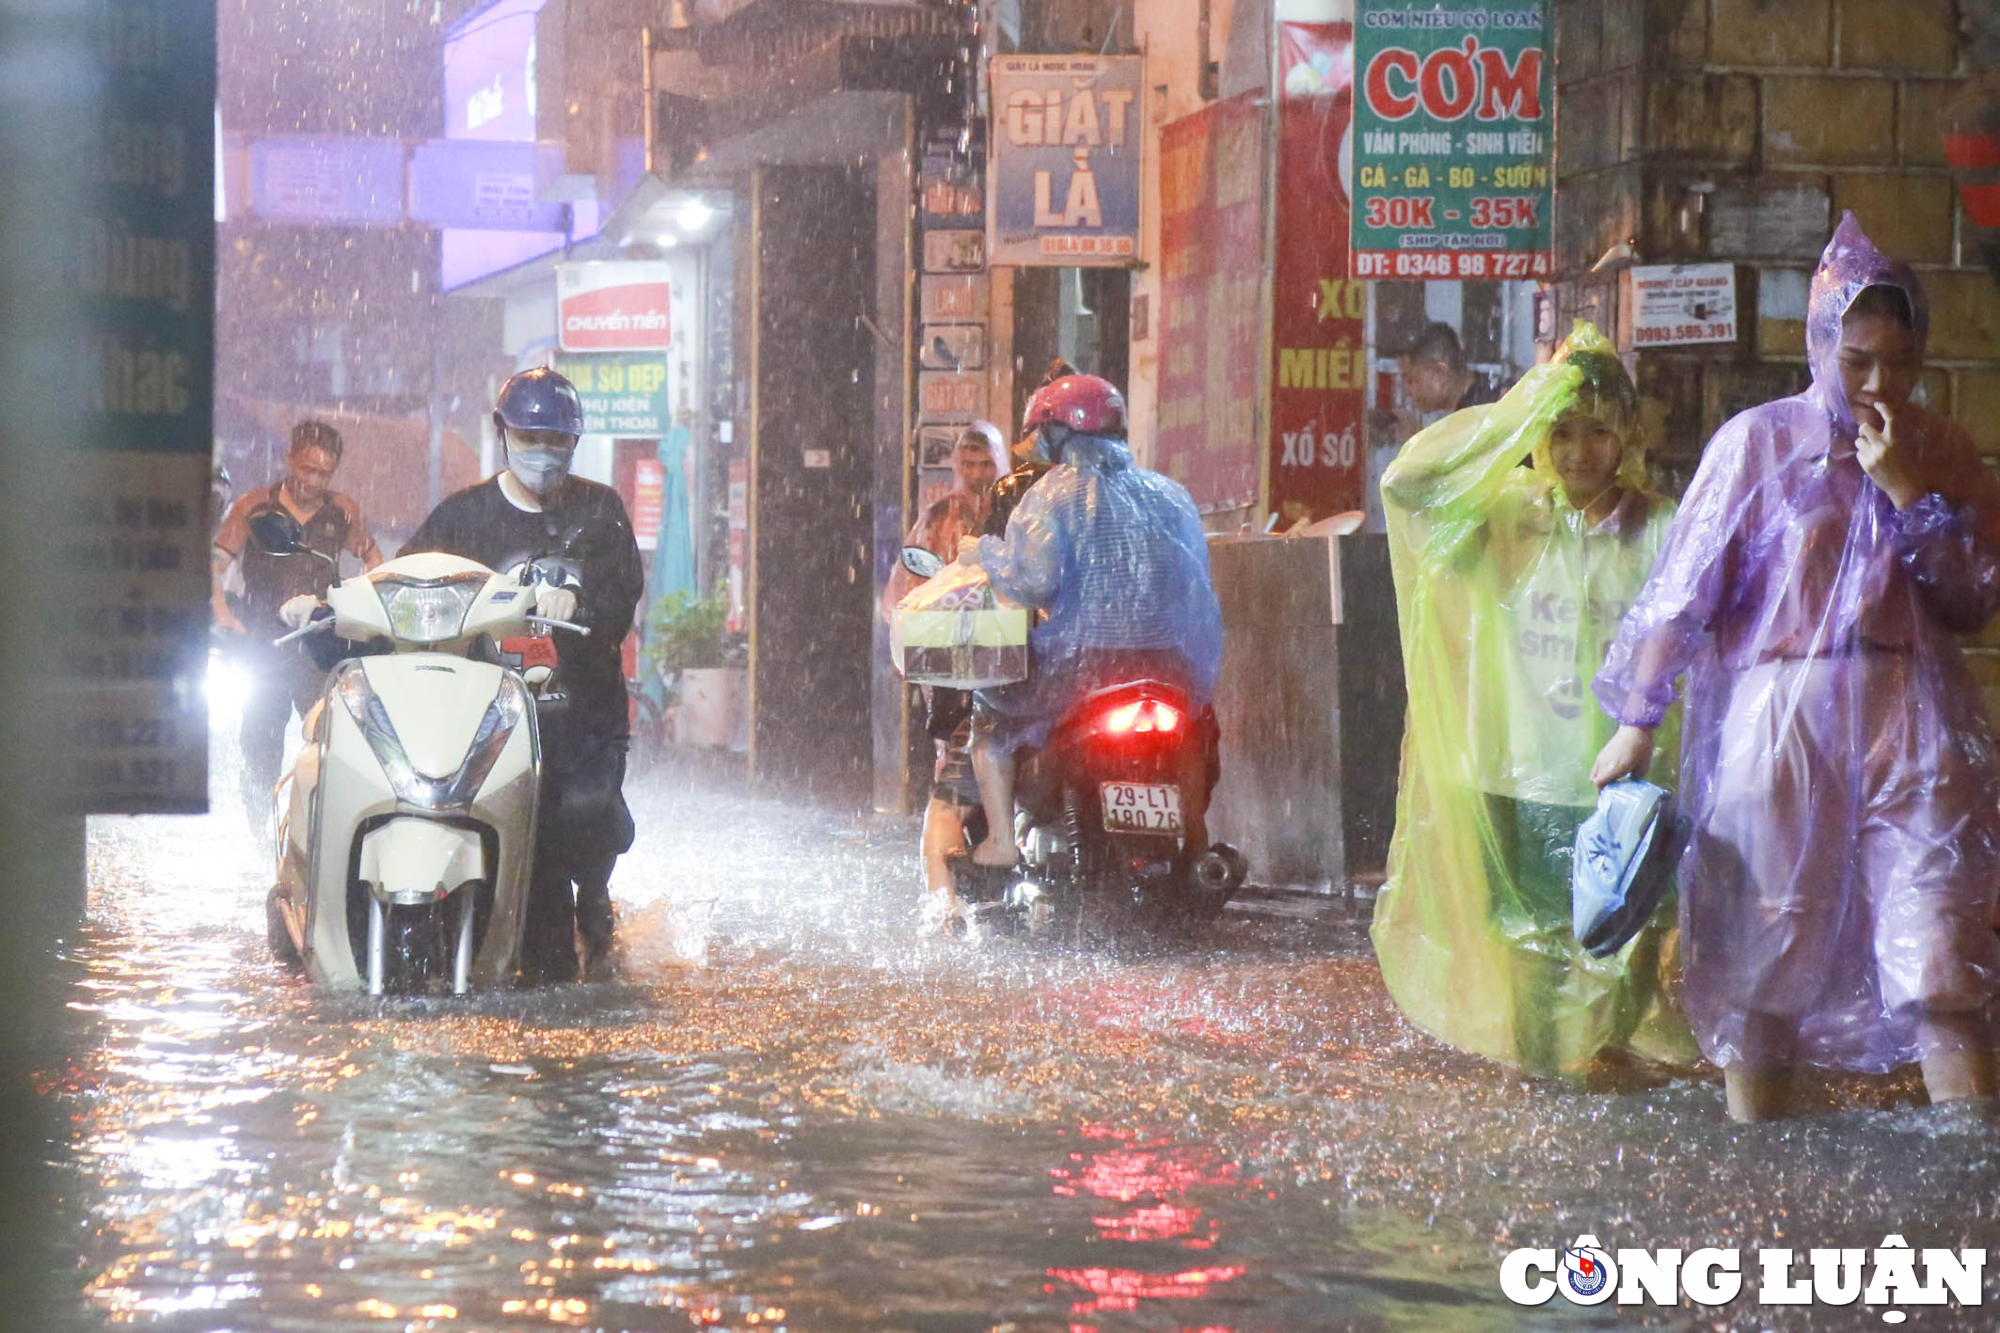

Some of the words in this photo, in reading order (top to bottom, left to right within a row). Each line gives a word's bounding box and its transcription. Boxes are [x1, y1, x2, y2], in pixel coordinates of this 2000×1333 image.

[1364, 34, 1544, 121] CƠM
[1466, 132, 1504, 154] SINH
[1366, 197, 1435, 229] 30K
[1470, 196, 1540, 229] 35K
[1396, 253, 1451, 275] 0346
[1458, 253, 1485, 275] 98
[1491, 253, 1547, 275] 7274
[1113, 786, 1169, 808] 29-L1
